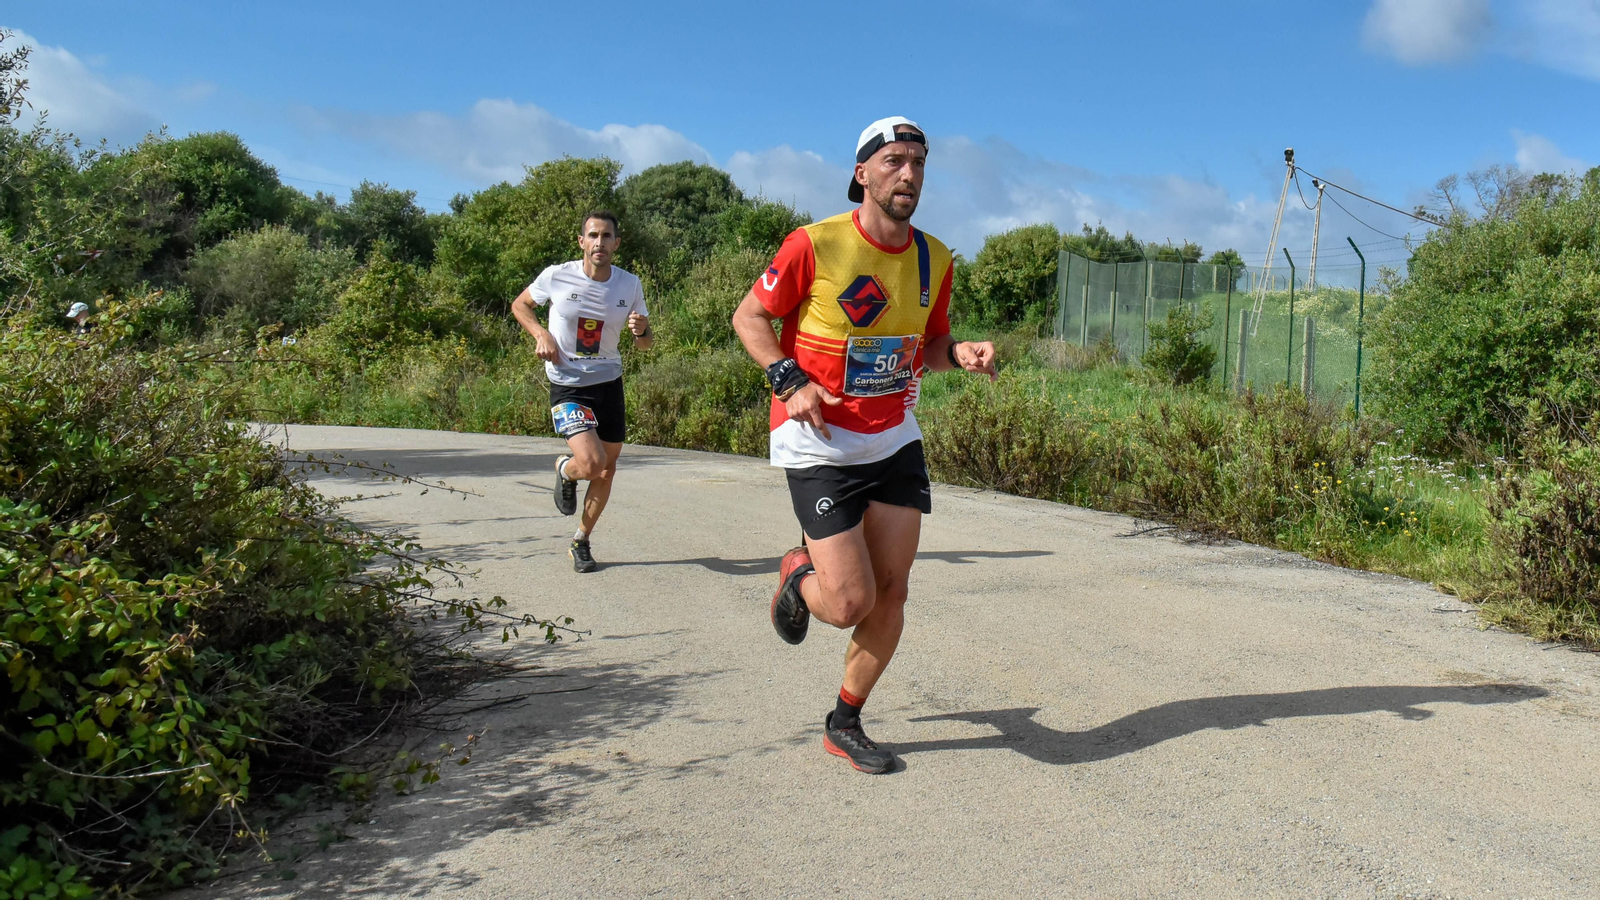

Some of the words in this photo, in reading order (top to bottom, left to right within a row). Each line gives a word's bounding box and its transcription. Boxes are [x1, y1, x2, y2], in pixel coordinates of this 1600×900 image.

[874, 354, 898, 373] 50
[855, 376, 893, 384] Carbonera
[894, 370, 911, 380] 2022
[562, 409, 584, 421] 140
